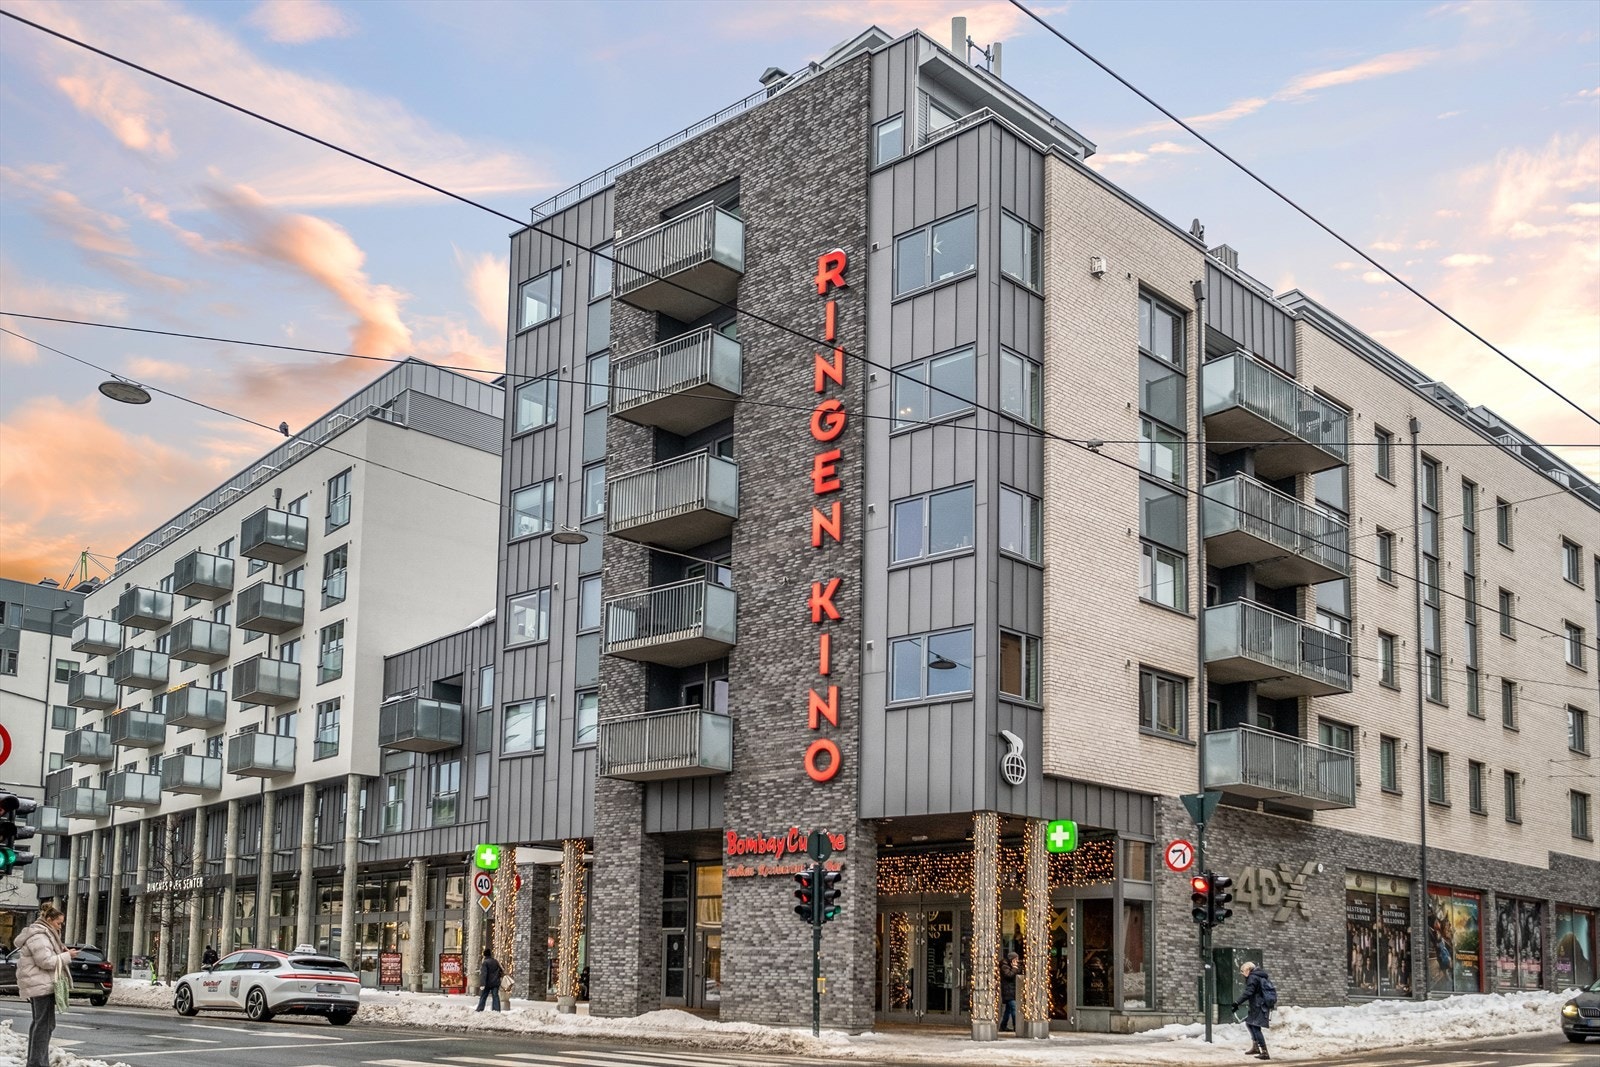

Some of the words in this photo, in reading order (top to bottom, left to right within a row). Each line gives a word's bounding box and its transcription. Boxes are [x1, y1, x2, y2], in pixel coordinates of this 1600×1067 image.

[810, 249, 848, 548] RINGEN
[803, 576, 842, 783] KINO
[726, 830, 785, 859] Bombay
[786, 827, 845, 853] Cune
[183, 877, 204, 890] SENTER
[477, 878, 490, 890] 40
[1234, 861, 1318, 922] 4DX
